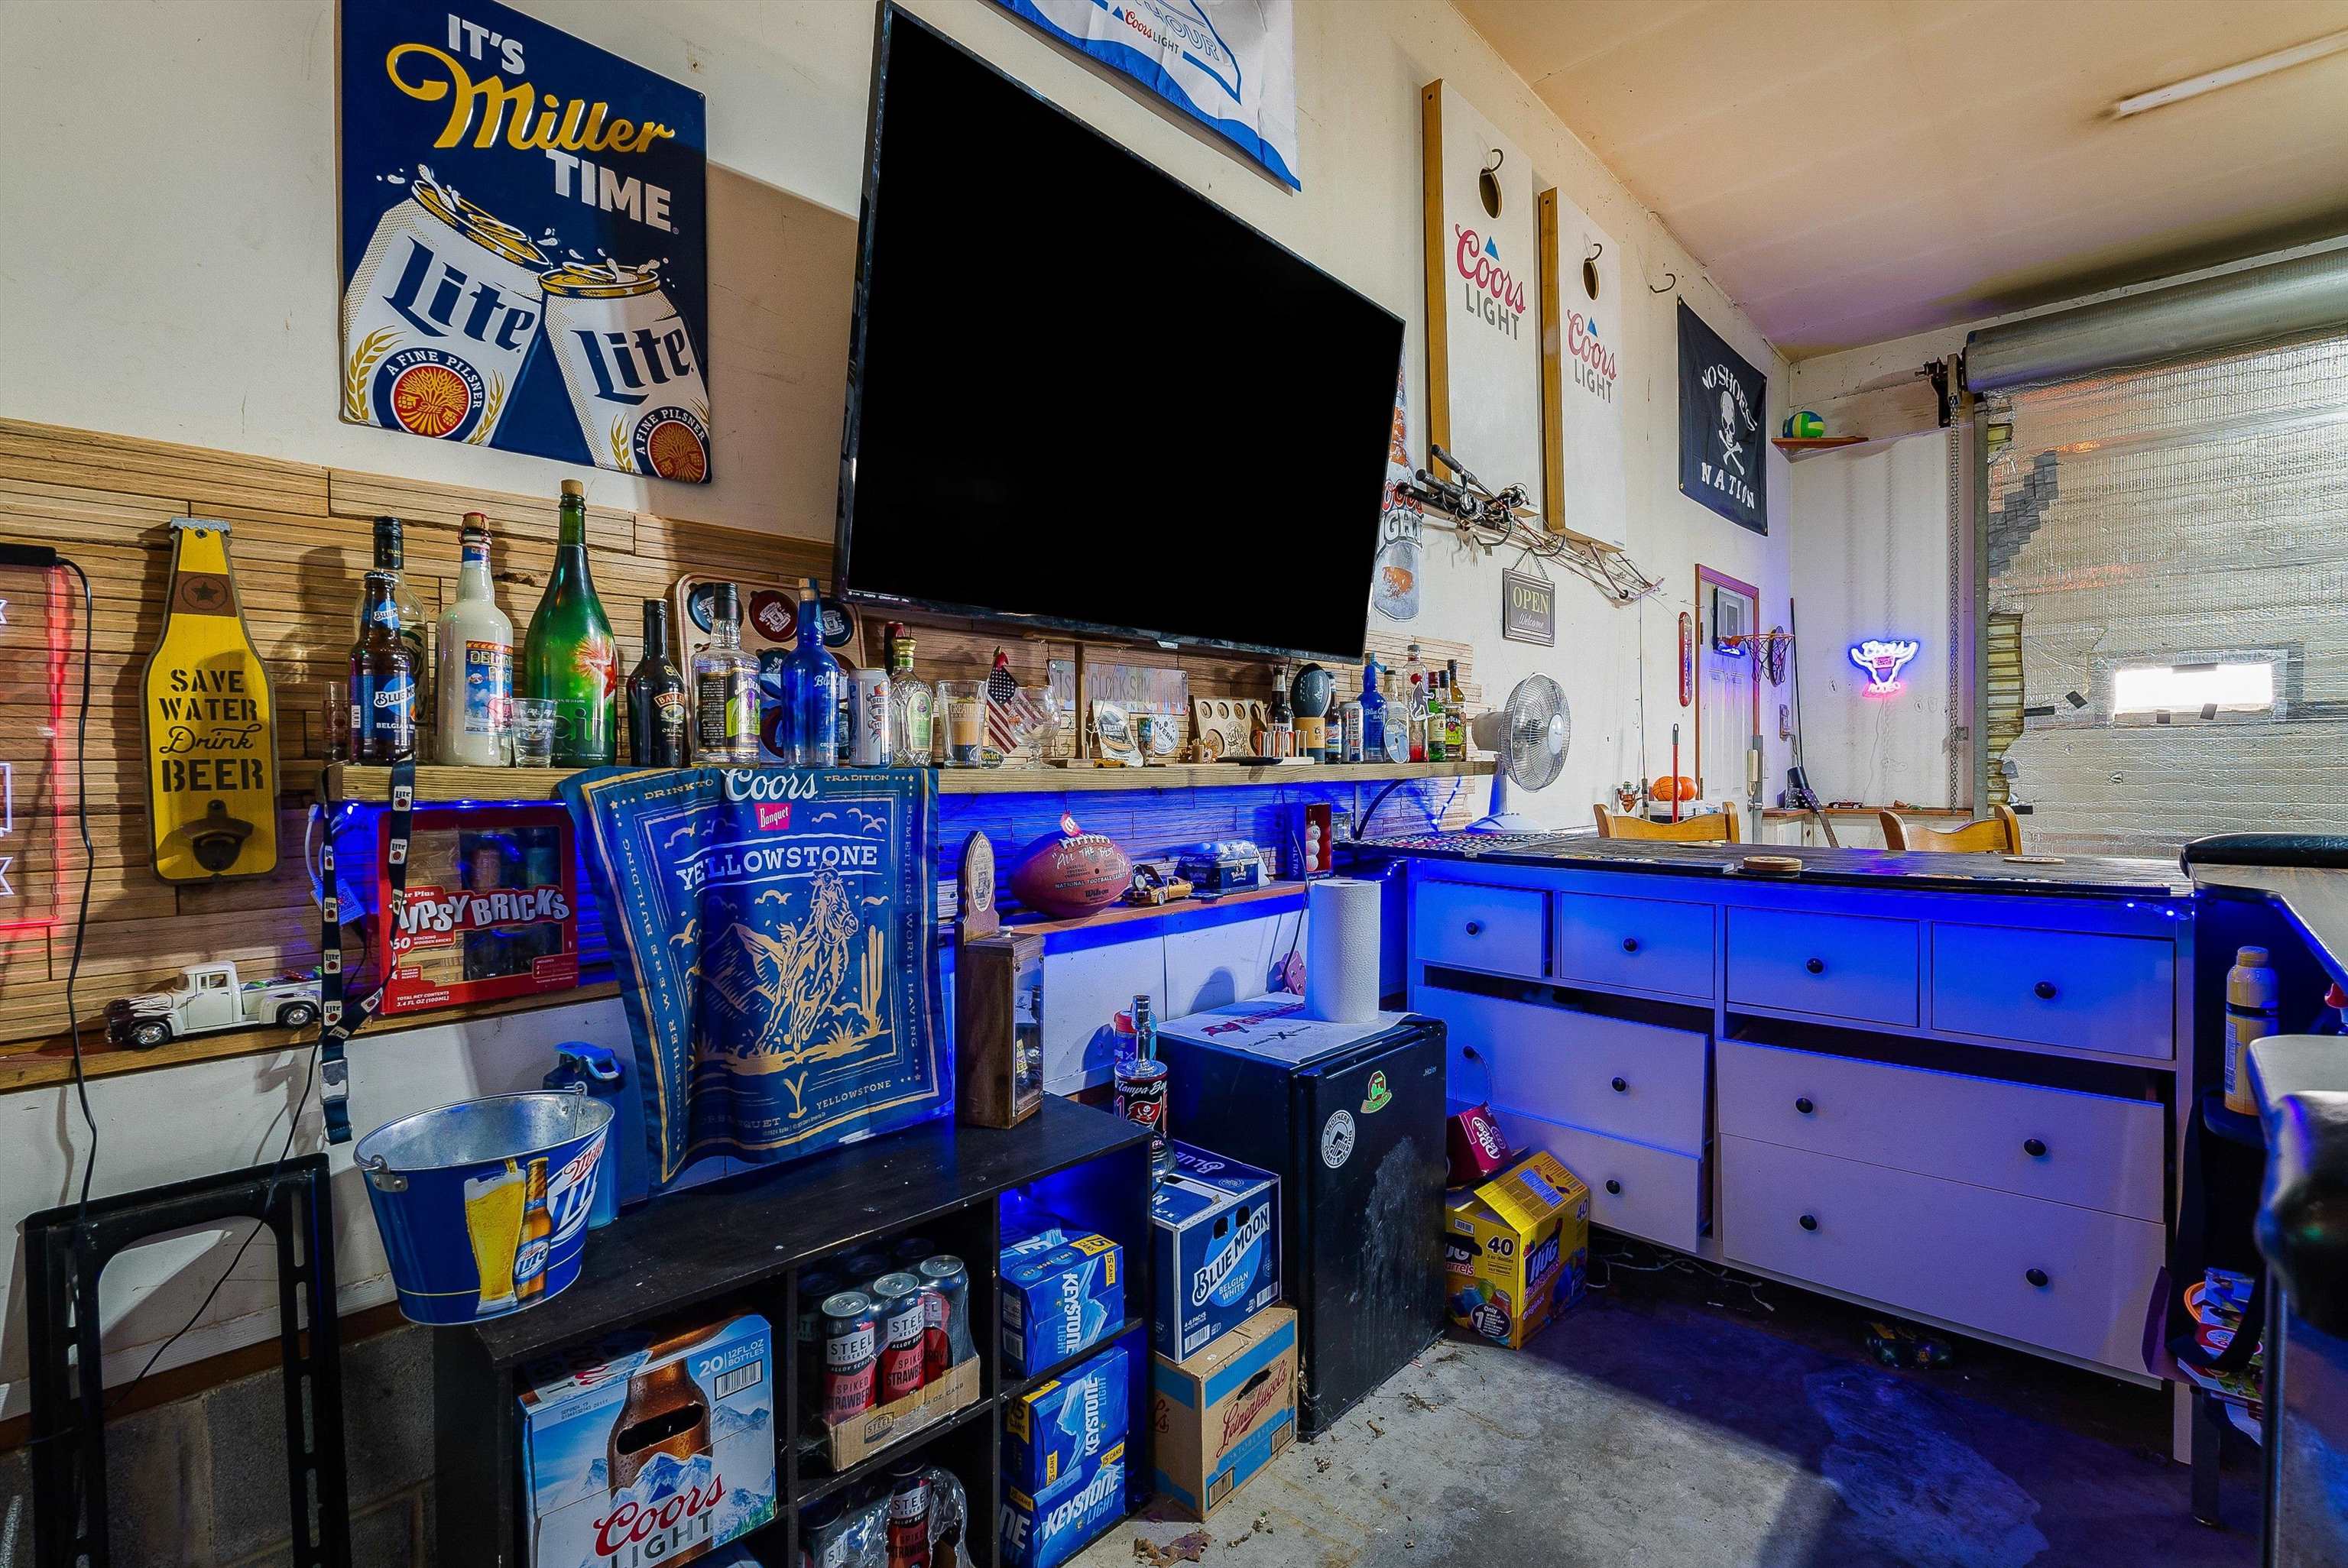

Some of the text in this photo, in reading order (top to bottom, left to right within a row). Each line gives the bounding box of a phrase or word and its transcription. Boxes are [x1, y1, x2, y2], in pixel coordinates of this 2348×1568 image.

[448, 13, 526, 75] IT'S
[1125, 9, 1179, 54] Coors LIGHT
[386, 43, 676, 153] Miller
[546, 148, 672, 233] TIME
[1455, 223, 1526, 315] Coors
[381, 235, 537, 354] Lite
[1465, 282, 1519, 341] LIGHT
[1567, 309, 1617, 381] Coors
[385, 349, 483, 410] A FINE PILSNER
[569, 327, 696, 406] Lite
[1575, 358, 1613, 403] LIGHT
[635, 409, 707, 456] A FINE PILSNER
[1701, 462, 1756, 510] NATION
[1513, 586, 1549, 614] OPEN
[1518, 612, 1545, 630] Welcome
[170, 669, 245, 695] SAVE
[158, 697, 258, 723] WATER
[158, 723, 263, 755] Drink
[1154, 721, 1175, 744] AVERN
[161, 758, 264, 793] BEER
[644, 778, 715, 800] DRINK TO
[721, 767, 818, 802] Coors
[824, 774, 890, 782] TRADITION
[759, 805, 790, 829] Banquet
[1078, 847, 1095, 857] THE
[676, 846, 877, 892] YELLOWSTONE
[1056, 880, 1085, 889] NATIONAL
[1087, 875, 1112, 885] FOOTBALL
[471, 889, 570, 926] BRICKS
[1085, 889, 1109, 898] Wilson
[903, 804, 918, 1048] SOMETHING WORTH HAVING
[815, 1079, 892, 1110] YELLOWSTONE
[1118, 1080, 1150, 1097] Tampa
[1474, 1119, 1500, 1158] Pepper
[1476, 1131, 1488, 1148] Dr
[1085, 1236, 1105, 1246] 15
[1194, 1245, 1233, 1302] BLUE
[1234, 1207, 1269, 1258] MOON
[1487, 1236, 1515, 1257] 40
[517, 1249, 548, 1276] Lite
[1106, 1254, 1114, 1265] 15
[1445, 1262, 1474, 1276] arrels
[1218, 1271, 1249, 1295] BELGIAN
[1222, 1281, 1245, 1301] WHITE
[1062, 1272, 1082, 1354] KEYSTONE
[1483, 1305, 1498, 1315] Only
[831, 1334, 872, 1356] STEEL
[1057, 1325, 1065, 1355] LIGHT
[699, 1356, 724, 1378] 20
[728, 1347, 764, 1367] BOTTLES
[836, 1376, 869, 1395] SPIKED
[868, 1416, 890, 1434] STEEL
[1084, 1376, 1101, 1456] KEYSTONE
[1101, 1447, 1123, 1466] 15 CANS
[593, 1473, 726, 1557] Coors
[1043, 1469, 1120, 1541] KEYSTONE
[1086, 1491, 1116, 1525] LIGHT
